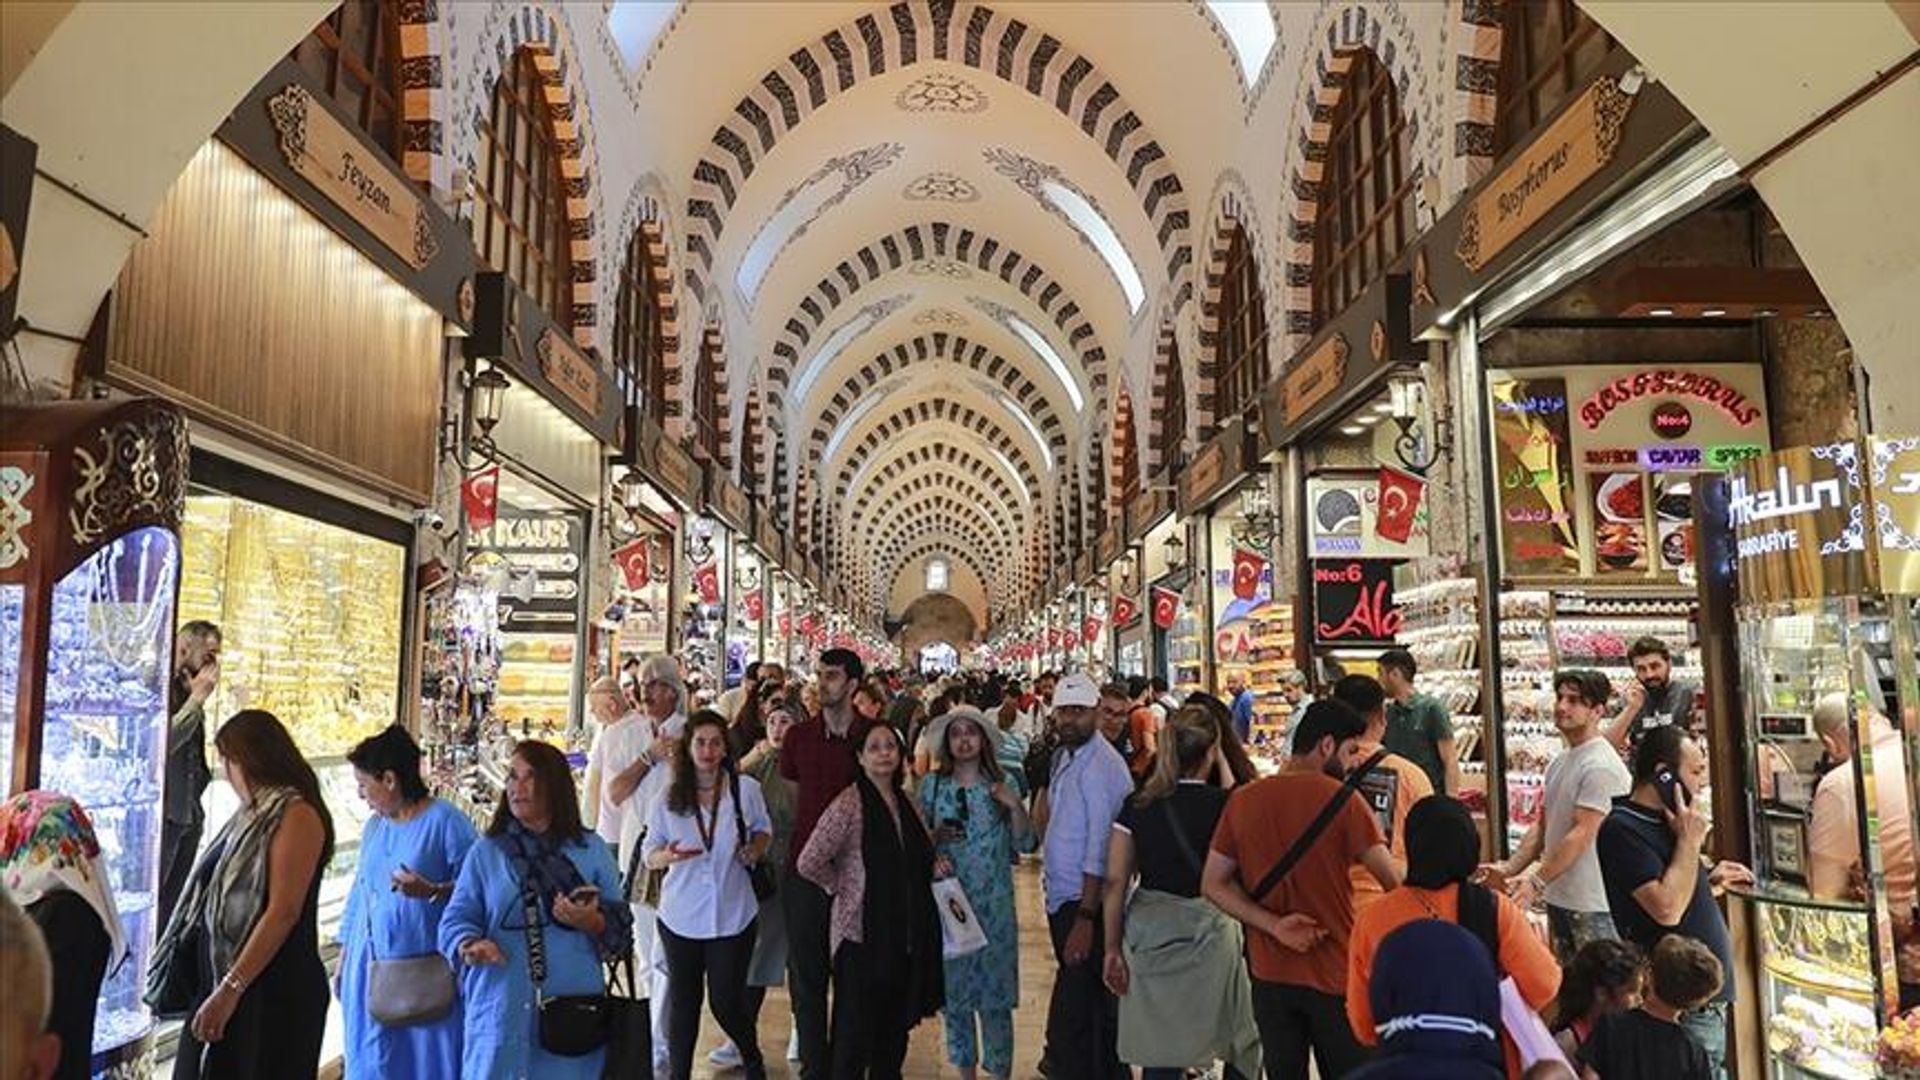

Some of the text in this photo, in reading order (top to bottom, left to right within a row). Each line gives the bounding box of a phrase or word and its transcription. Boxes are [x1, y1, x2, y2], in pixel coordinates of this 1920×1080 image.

[338, 152, 391, 214] Feyzan
[1498, 142, 1569, 223] Bosphorus
[1648, 448, 1702, 465] CAVIAR
[1316, 564, 1362, 582] No:6
